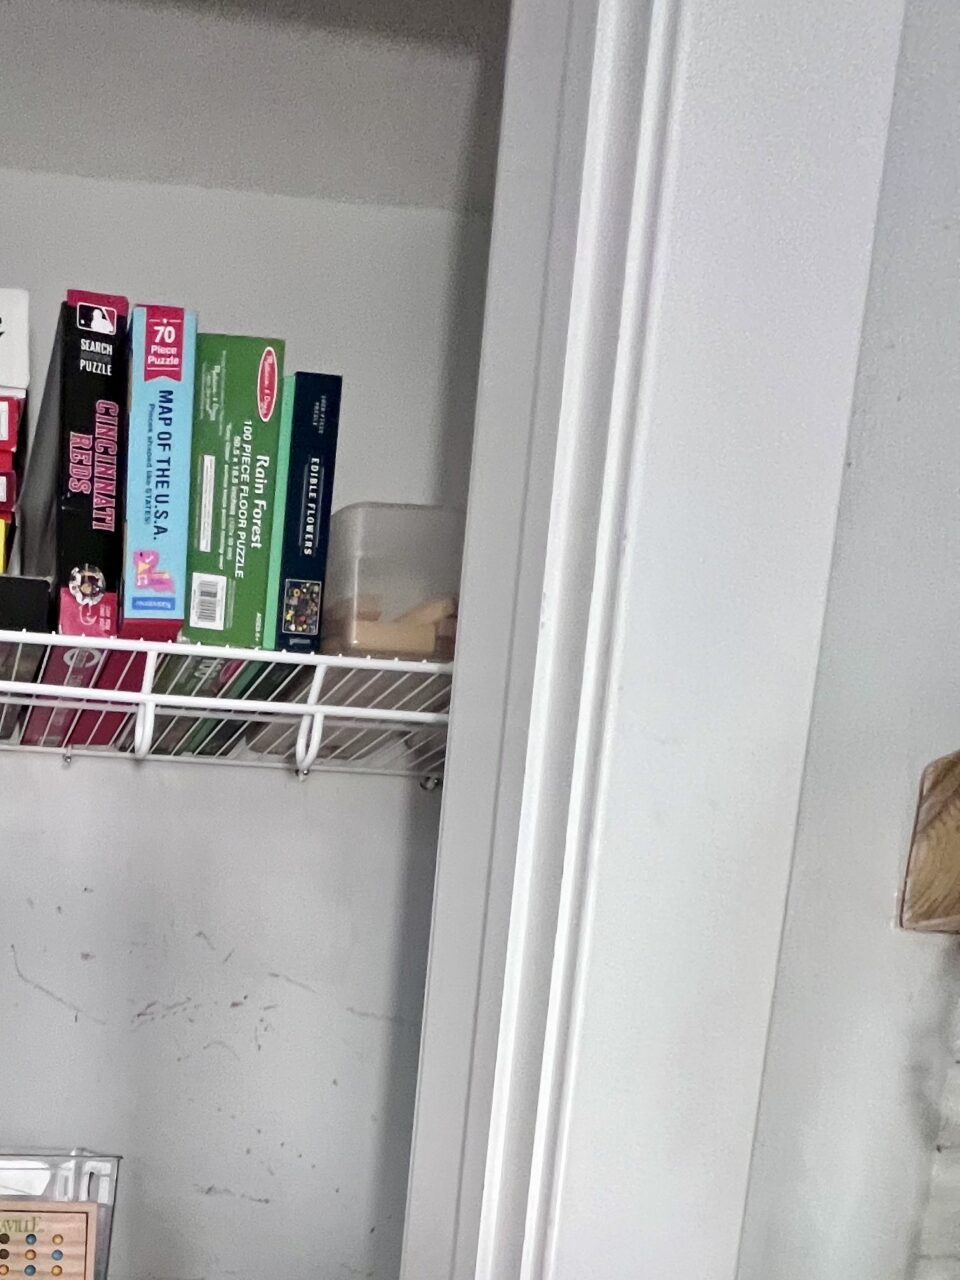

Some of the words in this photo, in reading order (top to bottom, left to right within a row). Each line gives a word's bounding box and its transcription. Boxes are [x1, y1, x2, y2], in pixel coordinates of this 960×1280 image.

[80, 338, 113, 356] SEARCH
[151, 345, 177, 355] Piece
[153, 325, 176, 344] 70
[80, 359, 113, 376] PUZZLE
[148, 355, 180, 366] Puzzle
[158, 390, 173, 427] MAP
[157, 432, 172, 452] OF
[243, 419, 253, 441] 100
[68, 431, 93, 495] REDS
[93, 399, 120, 532] CINCINNATI
[156, 456, 171, 489] THE
[240, 444, 251, 482] PIECE
[254, 455, 270, 494] Rain
[308, 457, 320, 499] EDIBLE
[153, 494, 169, 541] U.S.A.
[238, 485, 249, 528] FLOOR
[251, 499, 267, 549] Forest
[304, 503, 316, 556] FLOWERS
[234, 531, 247, 579] PUZZLE
